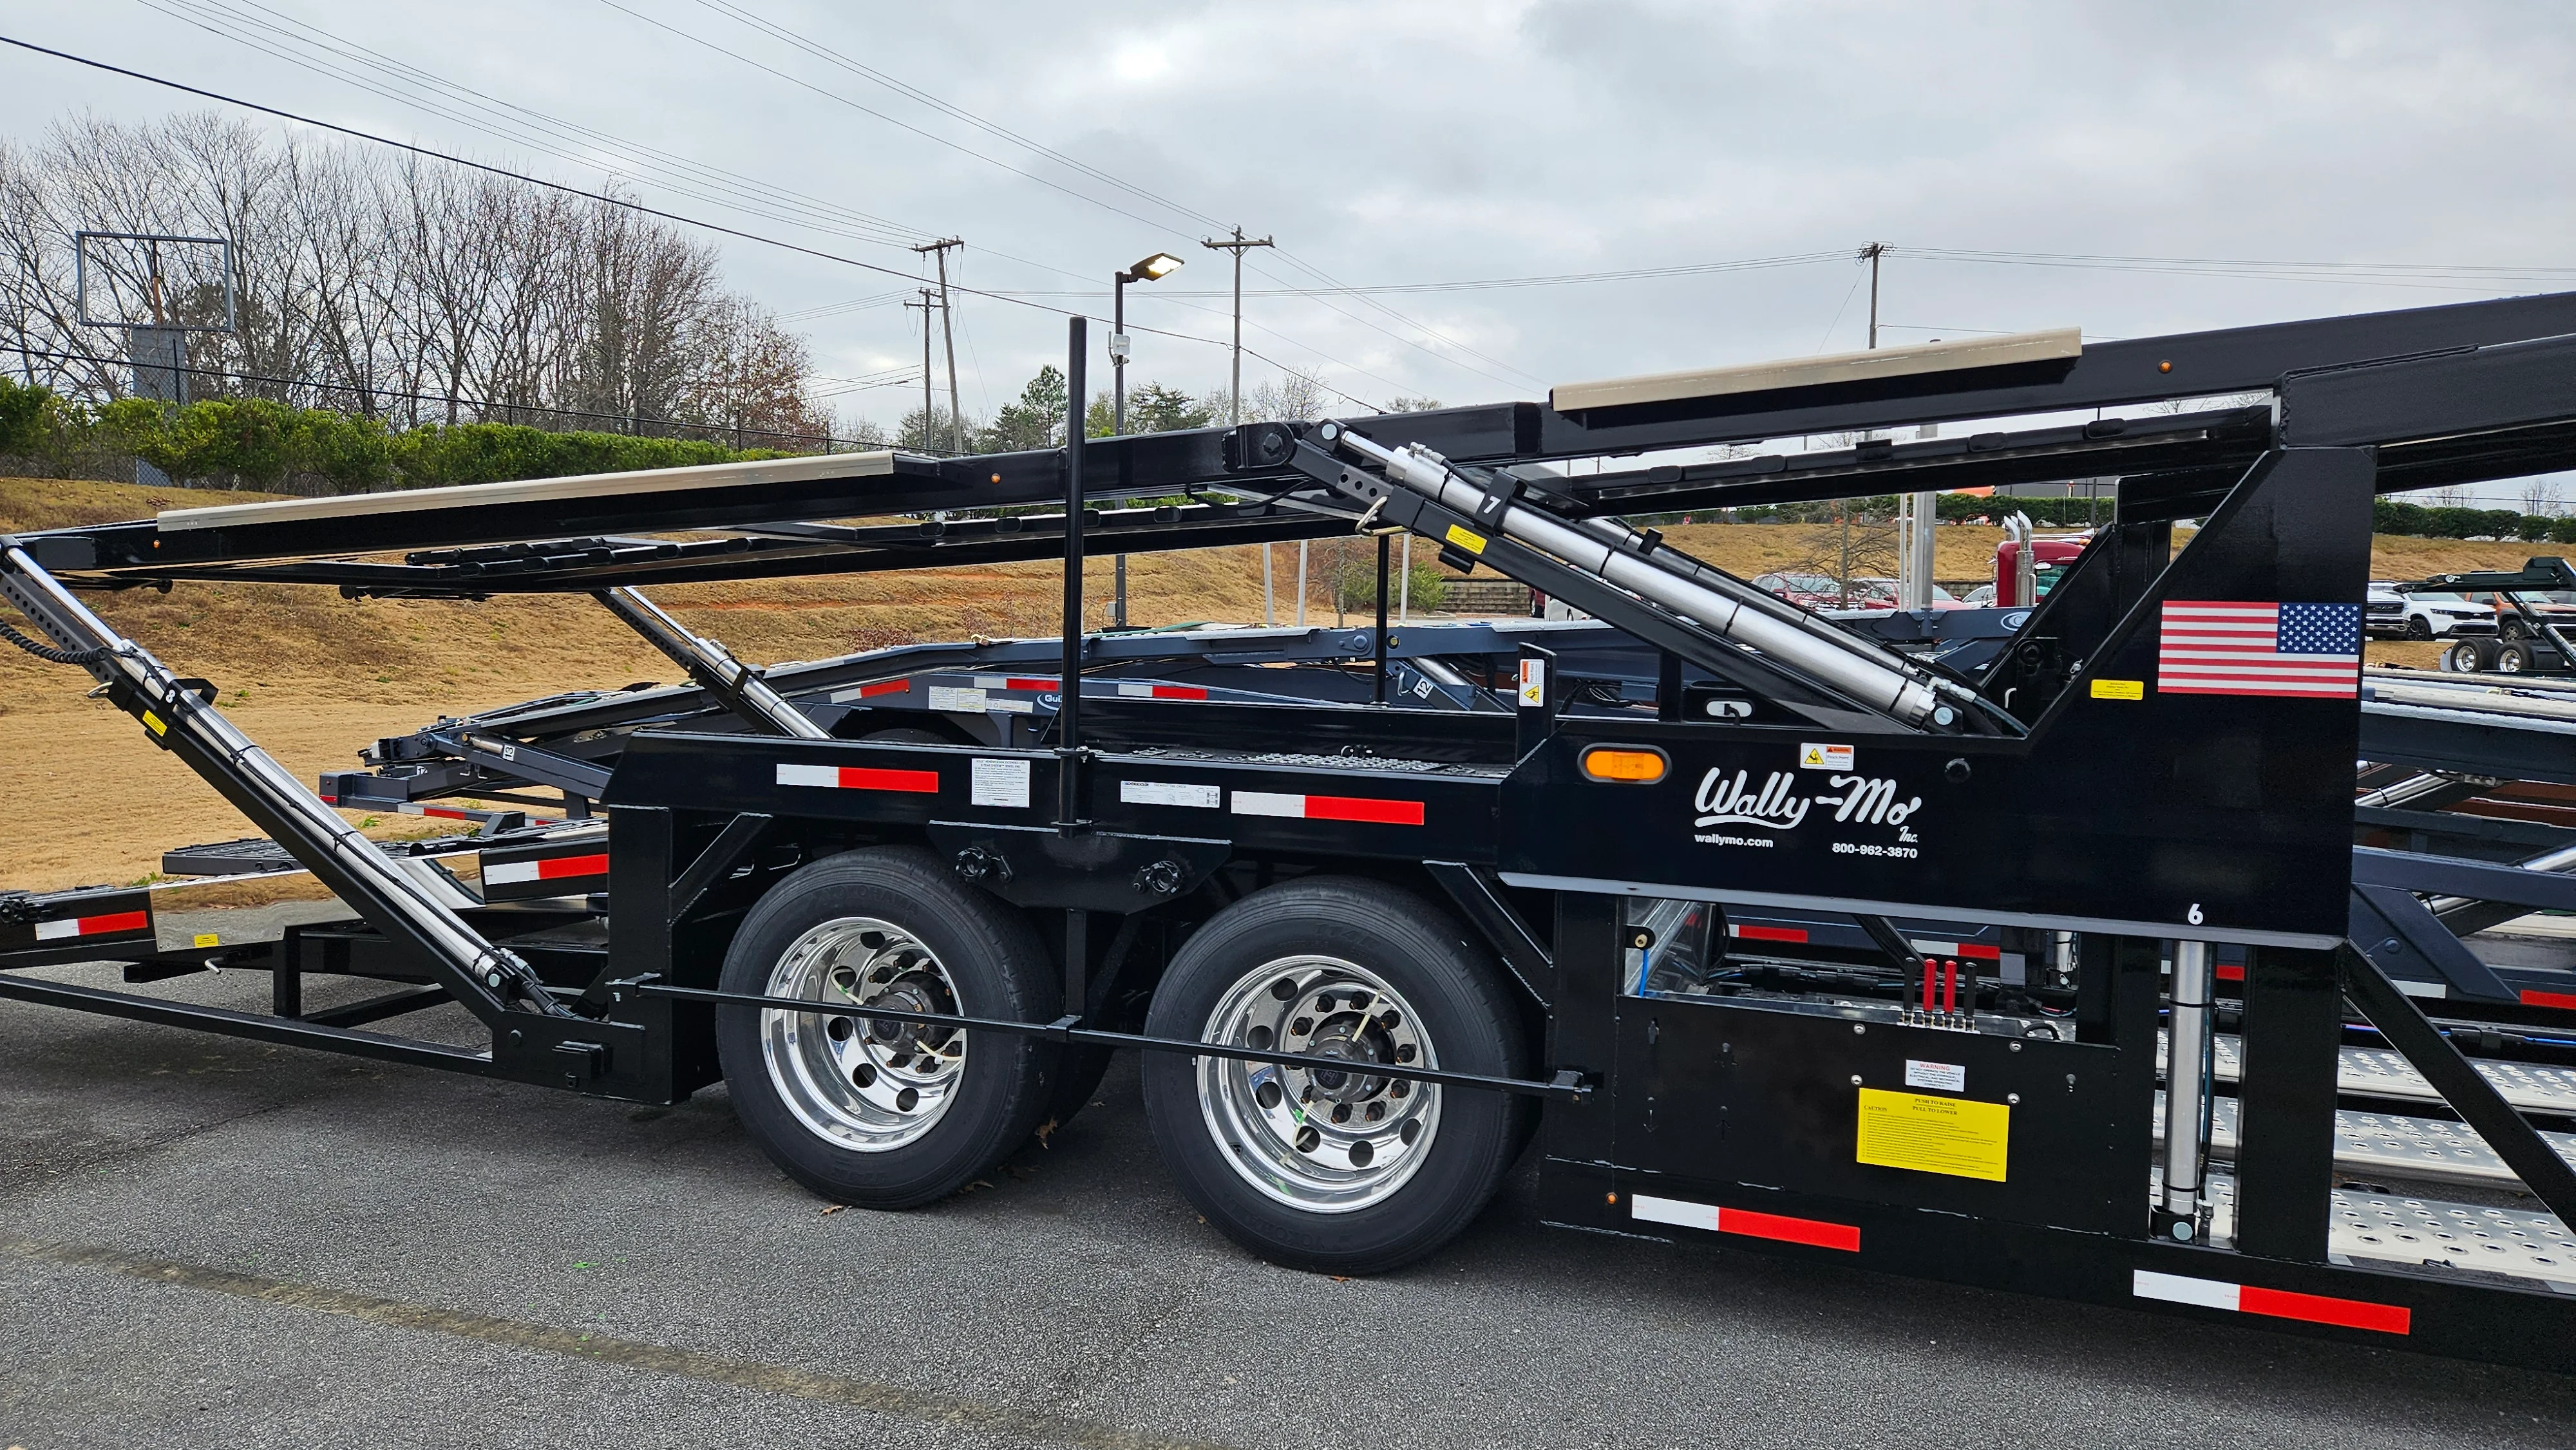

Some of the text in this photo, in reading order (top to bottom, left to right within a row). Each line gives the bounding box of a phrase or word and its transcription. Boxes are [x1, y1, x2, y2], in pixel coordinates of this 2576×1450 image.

[1484, 496, 1501, 513] 7
[1417, 681, 1432, 695] 12
[166, 689, 176, 704] 8
[1045, 694, 1063, 702] Qui
[505, 746, 514, 758] 13
[1695, 834, 1774, 848] wallymo.com
[1899, 825, 1918, 843] Inc.
[1832, 842, 1918, 859] 800-962-3870
[2188, 904, 2203, 925] 6
